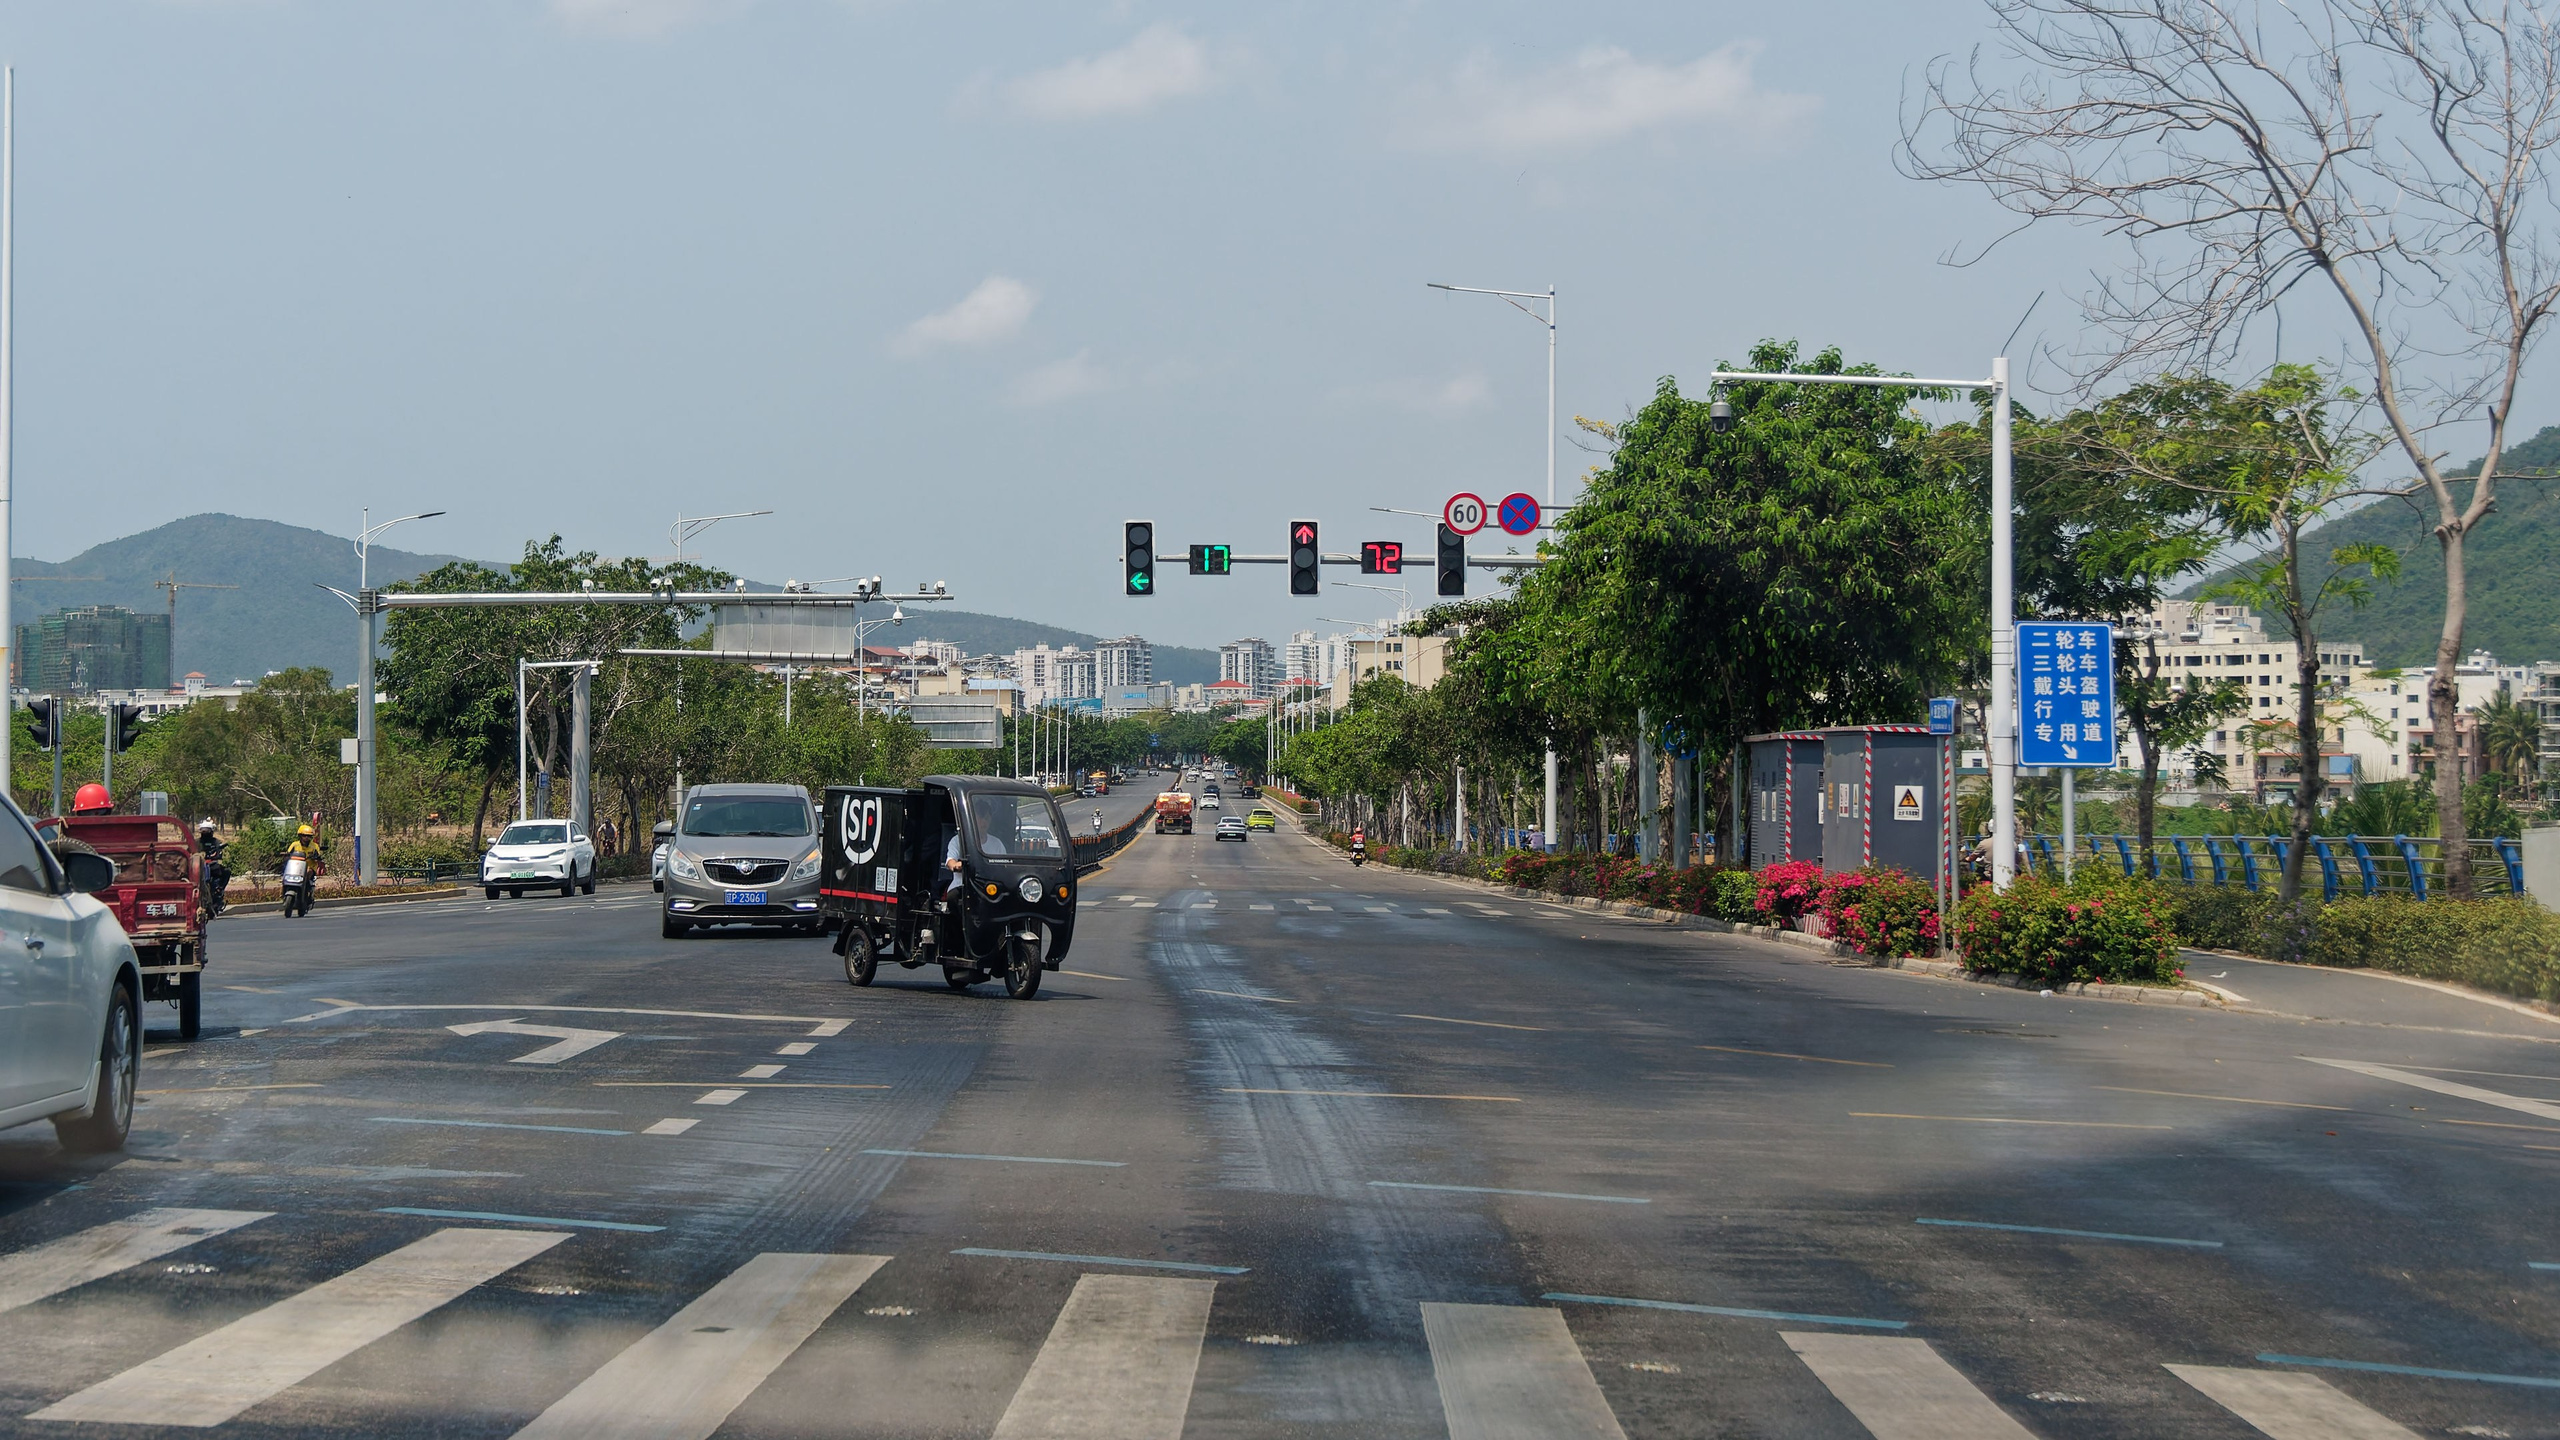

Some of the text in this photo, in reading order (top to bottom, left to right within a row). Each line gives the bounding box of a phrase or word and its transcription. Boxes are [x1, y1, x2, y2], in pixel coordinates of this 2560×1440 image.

[1453, 504, 1478, 523] 60
[1204, 545, 1229, 572] 17
[1365, 544, 1400, 573] 72
[2031, 630, 2097, 650] 二轮车
[2032, 653, 2098, 673] 三轮车
[2033, 676, 2099, 696] 戴头盔
[2034, 699, 2101, 719] 行驶
[2034, 722, 2103, 742] 专用道
[146, 903, 177, 916] 车辆
